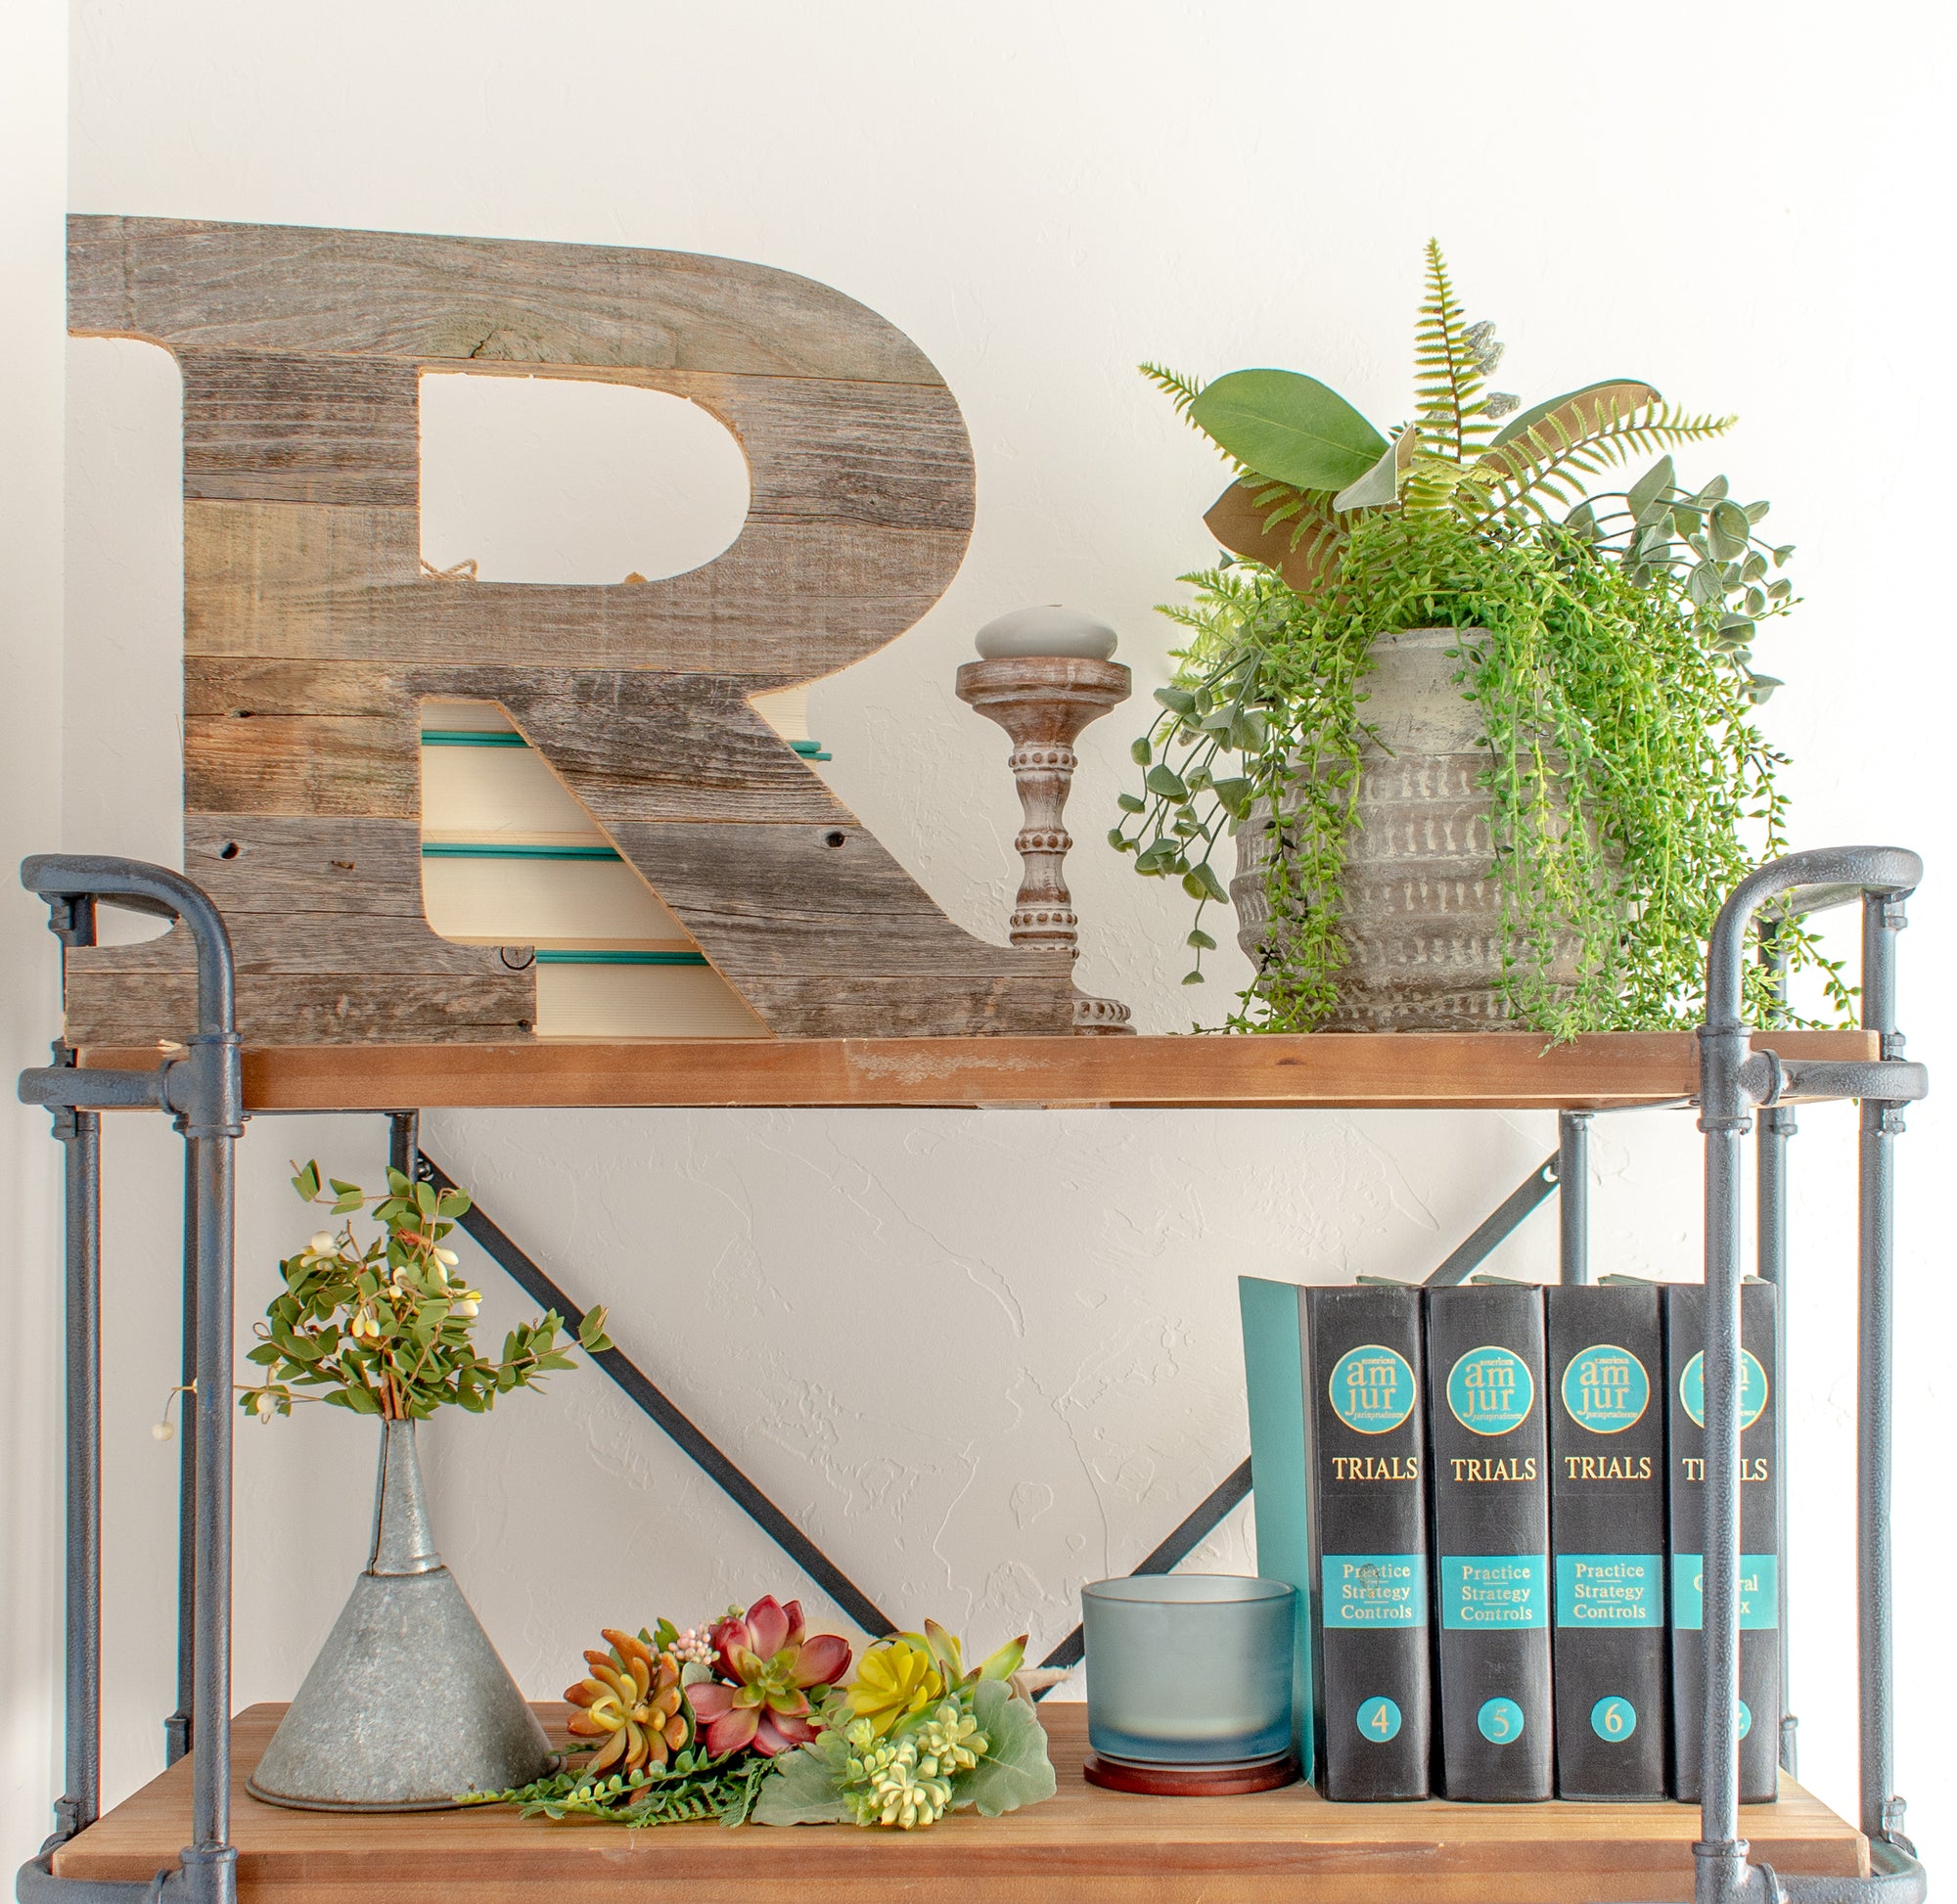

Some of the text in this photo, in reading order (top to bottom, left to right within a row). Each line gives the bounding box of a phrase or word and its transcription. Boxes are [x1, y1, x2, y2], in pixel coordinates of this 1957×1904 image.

[1346, 1361, 1397, 1386] am
[1464, 1362, 1516, 1387] am
[1579, 1361, 1630, 1385] am
[1344, 1386, 1396, 1416] jur
[1462, 1388, 1515, 1417] jur
[1576, 1386, 1630, 1415] jur
[1353, 1411, 1404, 1421] jurisprudence
[1472, 1412, 1523, 1423] jurisprudence
[1586, 1411, 1637, 1421] jurisprudence
[1332, 1457, 1419, 1480] TRIALS
[1450, 1458, 1537, 1482] TRIALS
[1565, 1456, 1653, 1480] TRIALS
[1682, 1458, 1768, 1482] TLS
[1462, 1564, 1531, 1580] Practice
[1574, 1563, 1645, 1578] Practice
[1342, 1584, 1411, 1601] Strategy
[1461, 1586, 1530, 1603] Strategy
[1574, 1583, 1644, 1601] Strategy
[1341, 1605, 1413, 1619] Controls
[1460, 1607, 1533, 1621] Controls
[1572, 1604, 1646, 1619] Controls
[1371, 1703, 1389, 1735] 4
[1493, 1703, 1509, 1736] 5
[1605, 1702, 1622, 1733] 6
